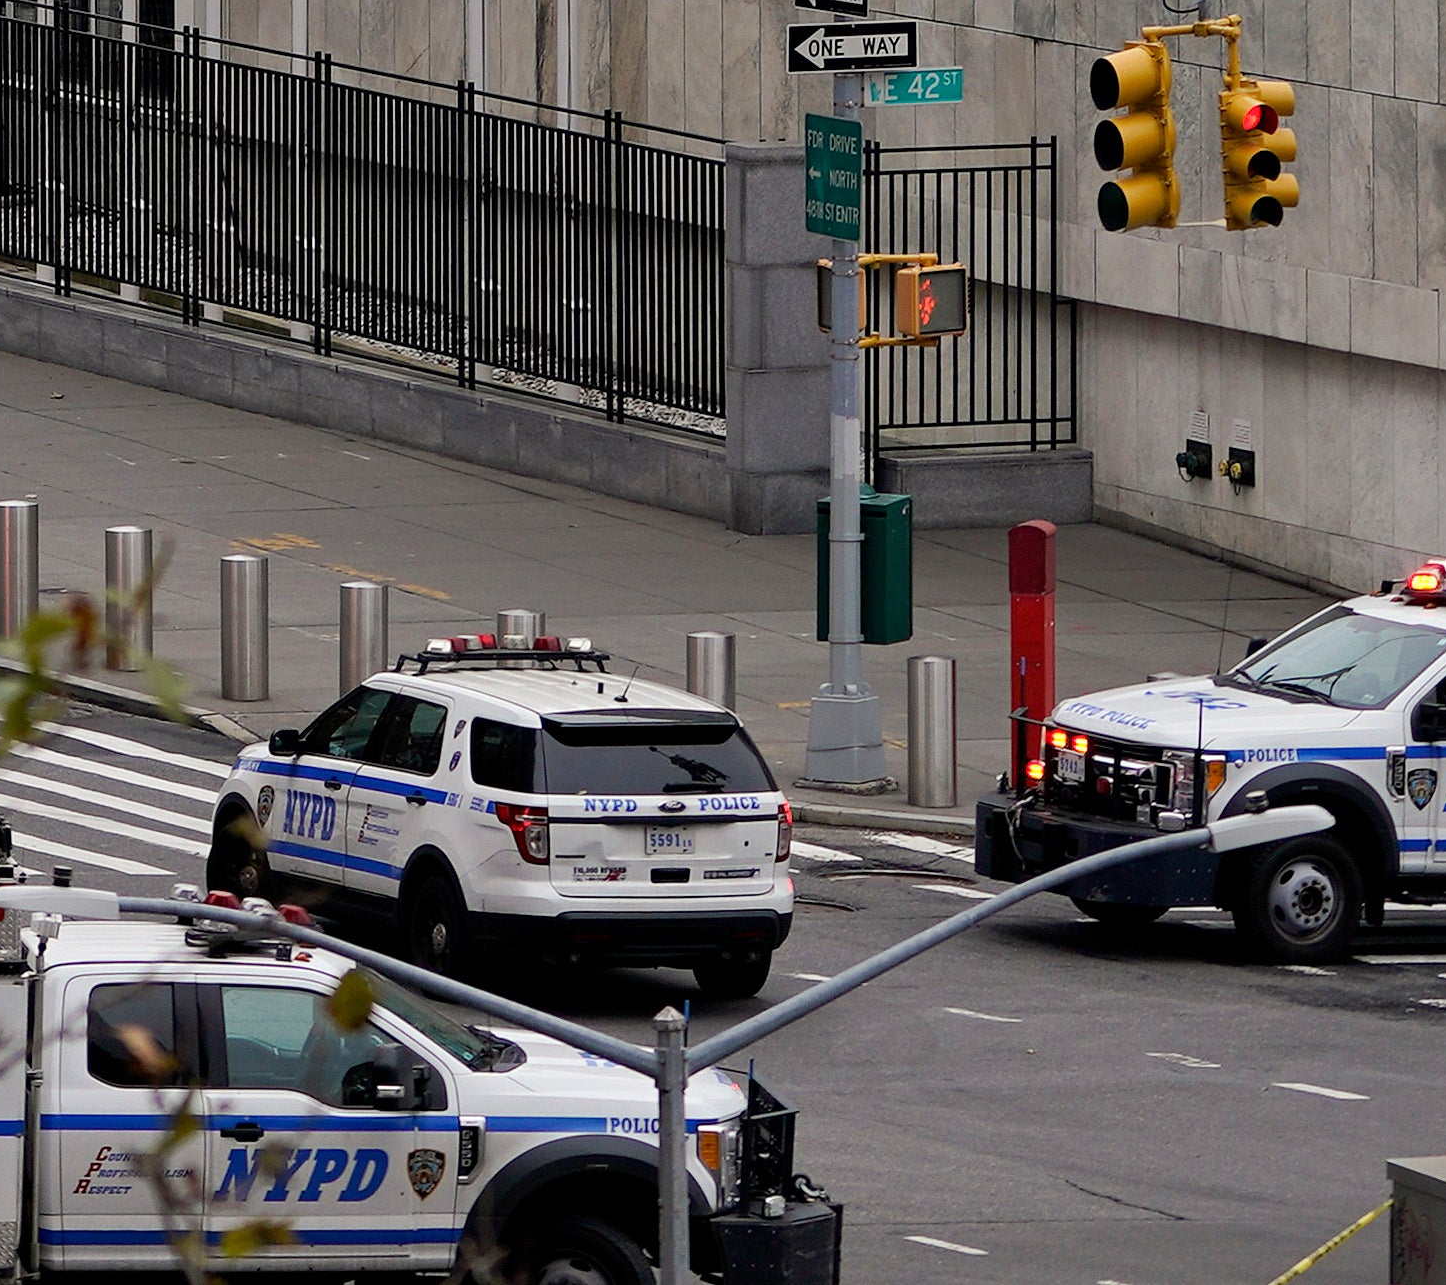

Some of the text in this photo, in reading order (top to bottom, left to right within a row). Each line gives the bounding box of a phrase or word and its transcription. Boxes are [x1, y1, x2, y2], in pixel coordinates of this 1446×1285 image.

[808, 36, 901, 57] ONE WAY
[884, 71, 958, 101] E 42 ST
[807, 128, 858, 156] FDR DRIVE
[828, 169, 858, 191] NORTH
[824, 204, 835, 221] ST
[835, 206, 860, 226] ENTR
[1065, 702, 1157, 731] NYPD POLICE
[1247, 748, 1297, 763] POLICE
[283, 788, 337, 842] NYPD
[583, 796, 760, 813] NYPD POLICE
[649, 833, 681, 848] 5591
[609, 1116, 659, 1134] POLIC
[211, 1147, 389, 1203] NYPD
[72, 1178, 133, 1195] RESPECT
